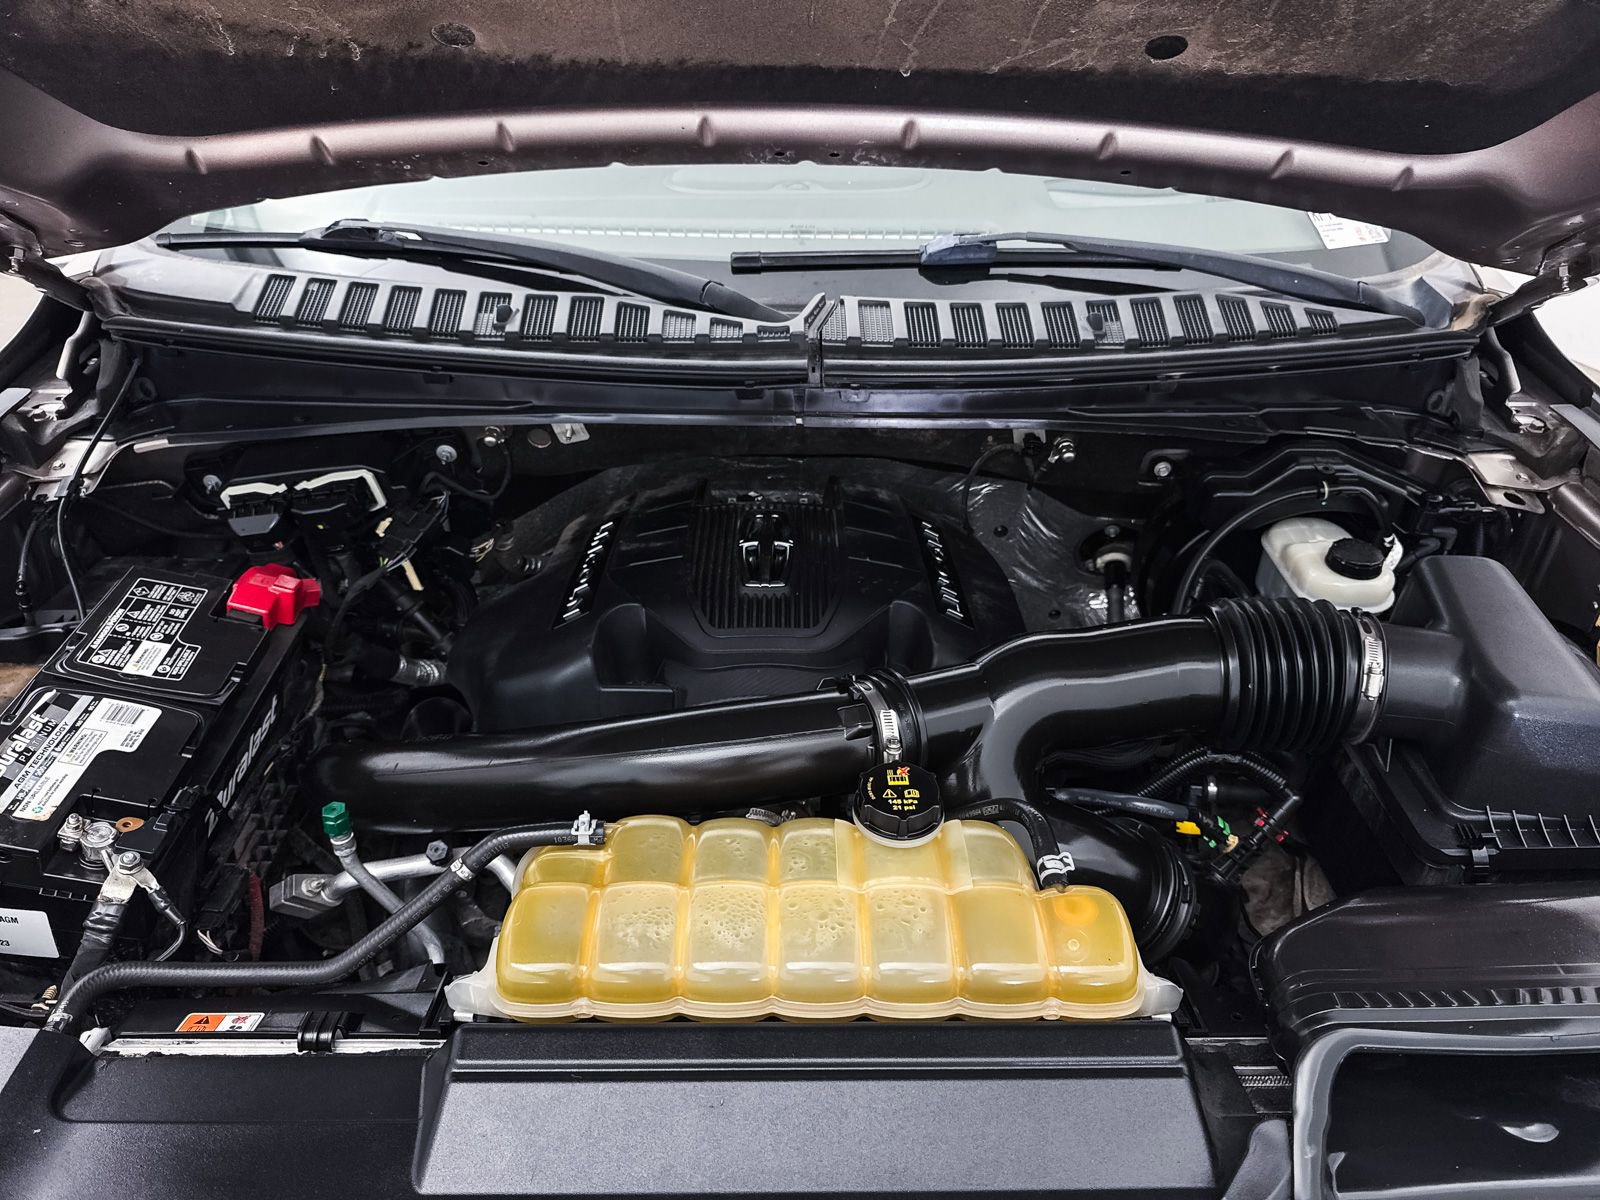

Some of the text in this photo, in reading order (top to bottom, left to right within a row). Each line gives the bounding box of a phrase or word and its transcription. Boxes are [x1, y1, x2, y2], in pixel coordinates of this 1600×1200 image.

[14, 769, 31, 789] AGM
[28, 721, 69, 770] TECHNOLOGY
[18, 719, 58, 763] PLATINUM
